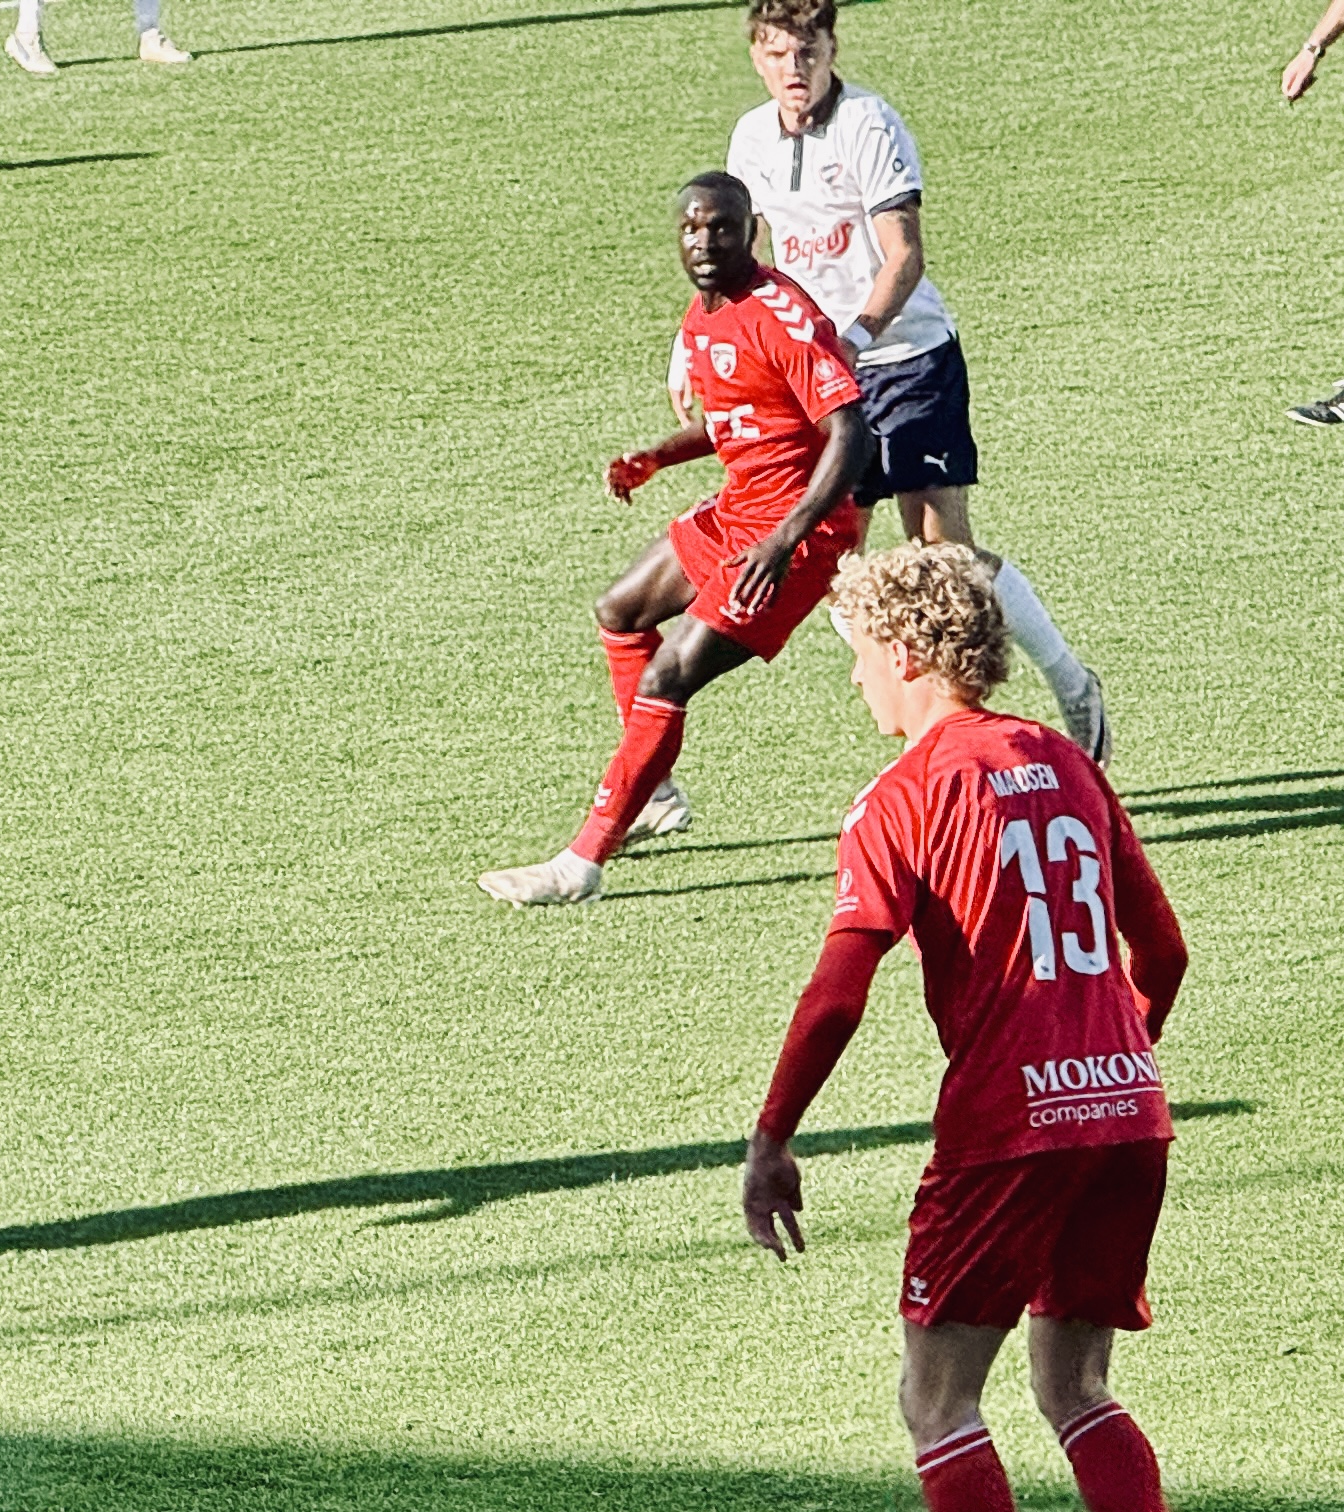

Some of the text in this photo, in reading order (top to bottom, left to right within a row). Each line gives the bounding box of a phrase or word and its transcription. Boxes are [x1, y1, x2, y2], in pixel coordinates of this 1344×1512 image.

[986, 763, 1060, 798] MADSEN
[1000, 815, 1110, 981] 13
[1029, 1099, 1139, 1128] companies
